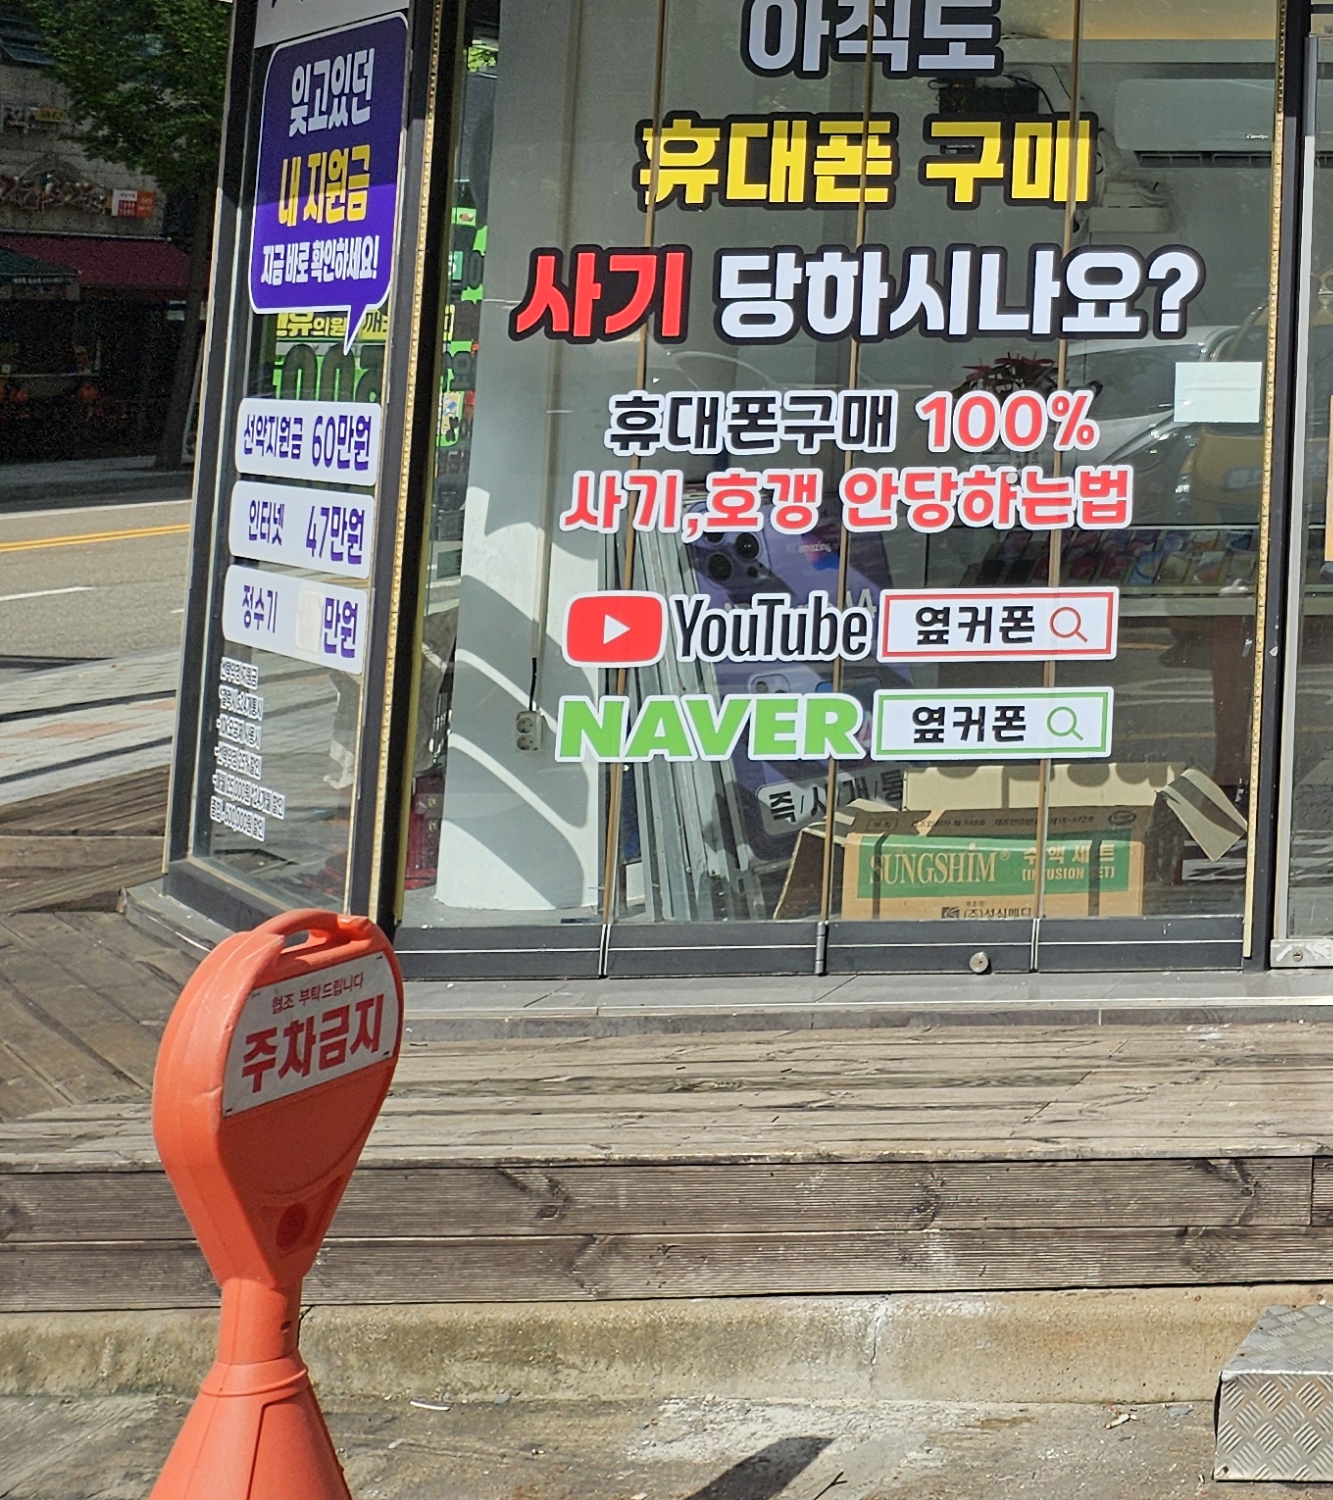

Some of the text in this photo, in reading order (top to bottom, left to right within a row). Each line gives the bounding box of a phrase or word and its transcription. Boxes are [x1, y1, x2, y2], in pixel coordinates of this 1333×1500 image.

[289, 48, 375, 137] 잊고있던
[278, 144, 370, 227] 내 지원금
[638, 119, 1090, 204] 휴대폰 구매
[261, 235, 380, 286] 지금 바로 확인하세요!
[515, 249, 1200, 338] 사기 당하시나요?
[244, 414, 372, 471] 선약지원금 60만원
[608, 392, 1097, 452] 휴대폰구매 100%
[843, 467, 1130, 532] 안당하는법
[249, 500, 366, 564] 인터넷 47만원
[242, 584, 278, 633] 정수기
[677, 596, 1035, 658] YouTube 옆커폰
[559, 698, 1027, 758] NAVER 옆커폰
[271, 971, 364, 1015] 협조 부탁드립니다
[241, 993, 384, 1093] 주차금지
